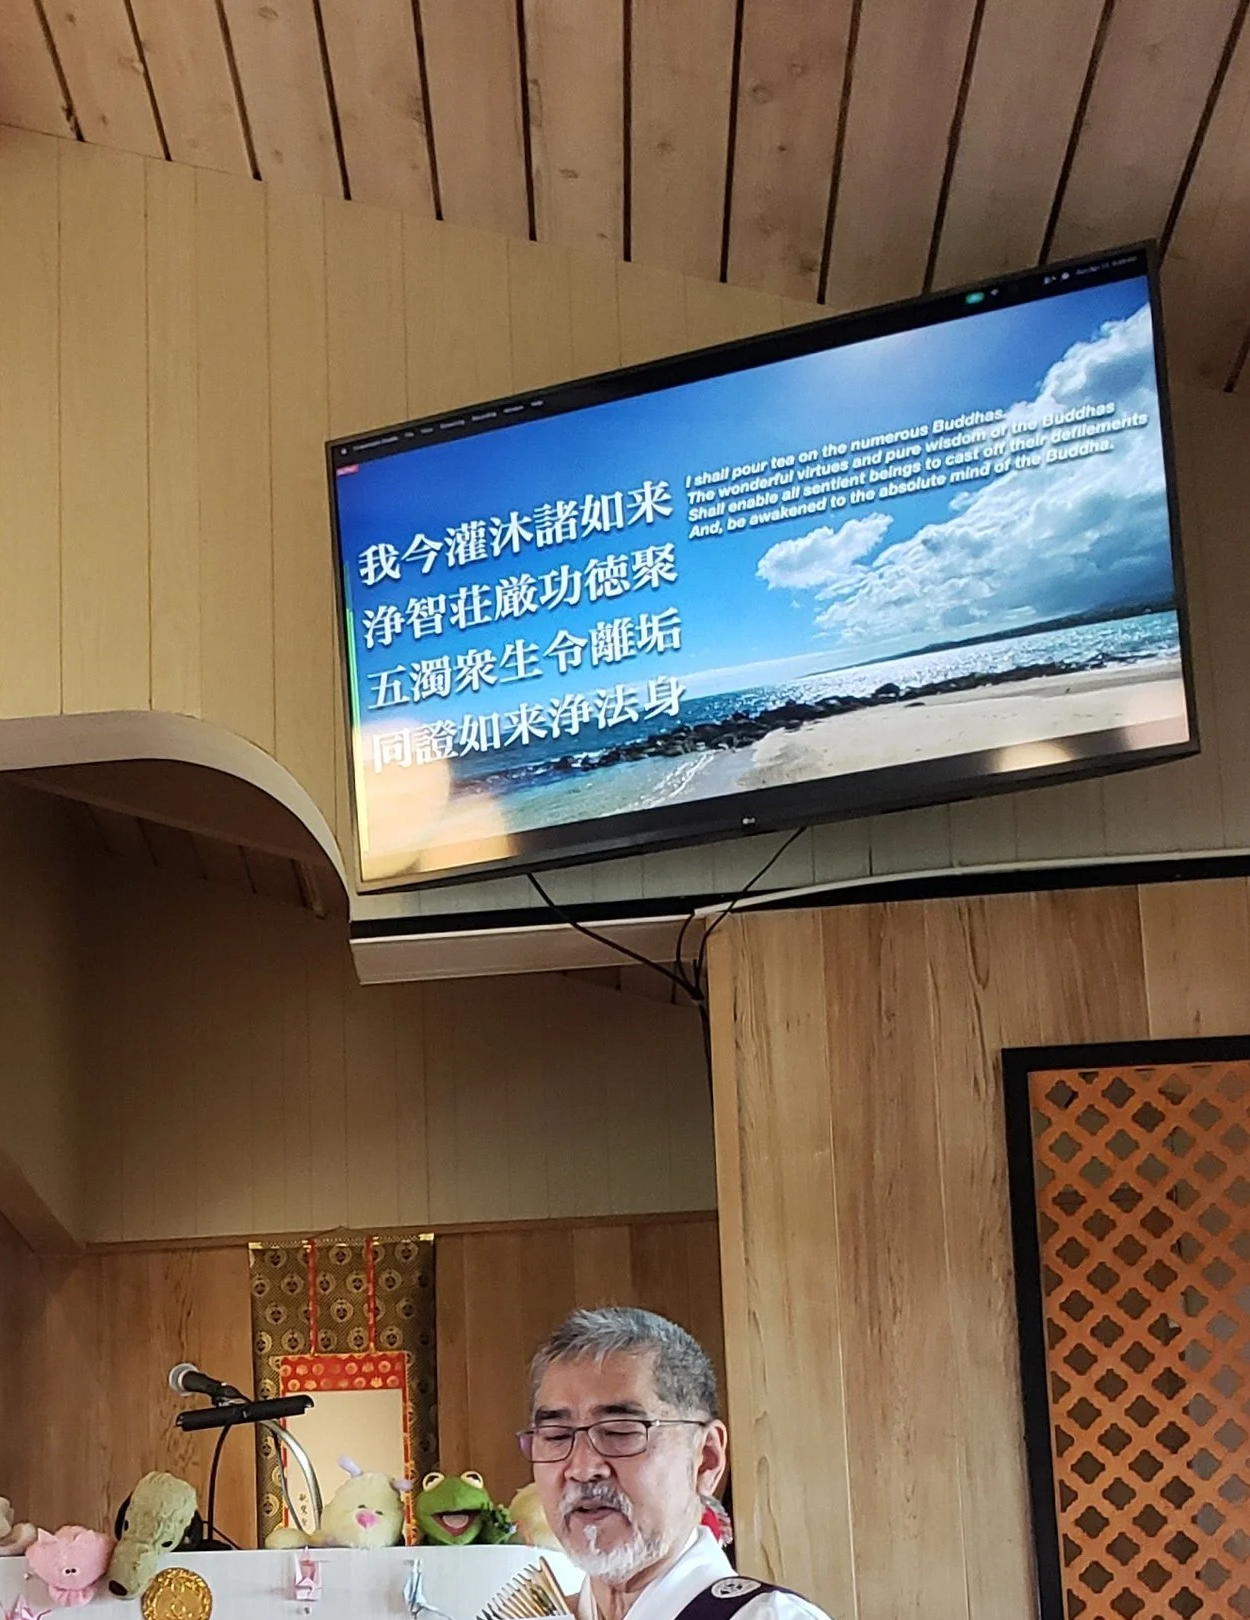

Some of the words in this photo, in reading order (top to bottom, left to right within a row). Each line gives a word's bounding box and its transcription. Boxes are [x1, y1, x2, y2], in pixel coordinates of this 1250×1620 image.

[685, 474, 692, 489] I
[694, 465, 730, 488] shall
[731, 458, 768, 482] pour
[771, 455, 795, 470] tea
[798, 450, 818, 464] on
[822, 442, 848, 459] the
[851, 424, 929, 451] numerous
[686, 490, 715, 505] The
[718, 470, 795, 498] wonderful
[798, 457, 849, 480] virtues
[852, 450, 882, 468] and
[885, 446, 922, 464] pure
[925, 431, 986, 454] wisdom
[990, 422, 1008, 439] of
[1011, 417, 1038, 435] the
[1041, 401, 1115, 428] Buddhas
[688, 504, 726, 522] Shall
[728, 491, 779, 513] enable
[781, 485, 801, 502] all
[803, 472, 866, 498] sentient
[869, 462, 922, 483] beings
[925, 455, 943, 471] to
[945, 447, 980, 466] cast
[983, 439, 1006, 458] off
[1009, 432, 1047, 453] their
[1050, 412, 1148, 444] defilements
[688, 519, 724, 540] And,
[726, 515, 746, 532] be
[749, 498, 827, 527] awakened
[830, 495, 846, 509] to
[850, 487, 875, 504] the
[878, 473, 947, 500] absolute
[950, 461, 991, 484] mind
[994, 458, 1011, 474] of
[1014, 451, 1042, 469] the
[1045, 439, 1114, 464] Buddha.
[358, 480, 673, 586] 我今灌沐諸如来
